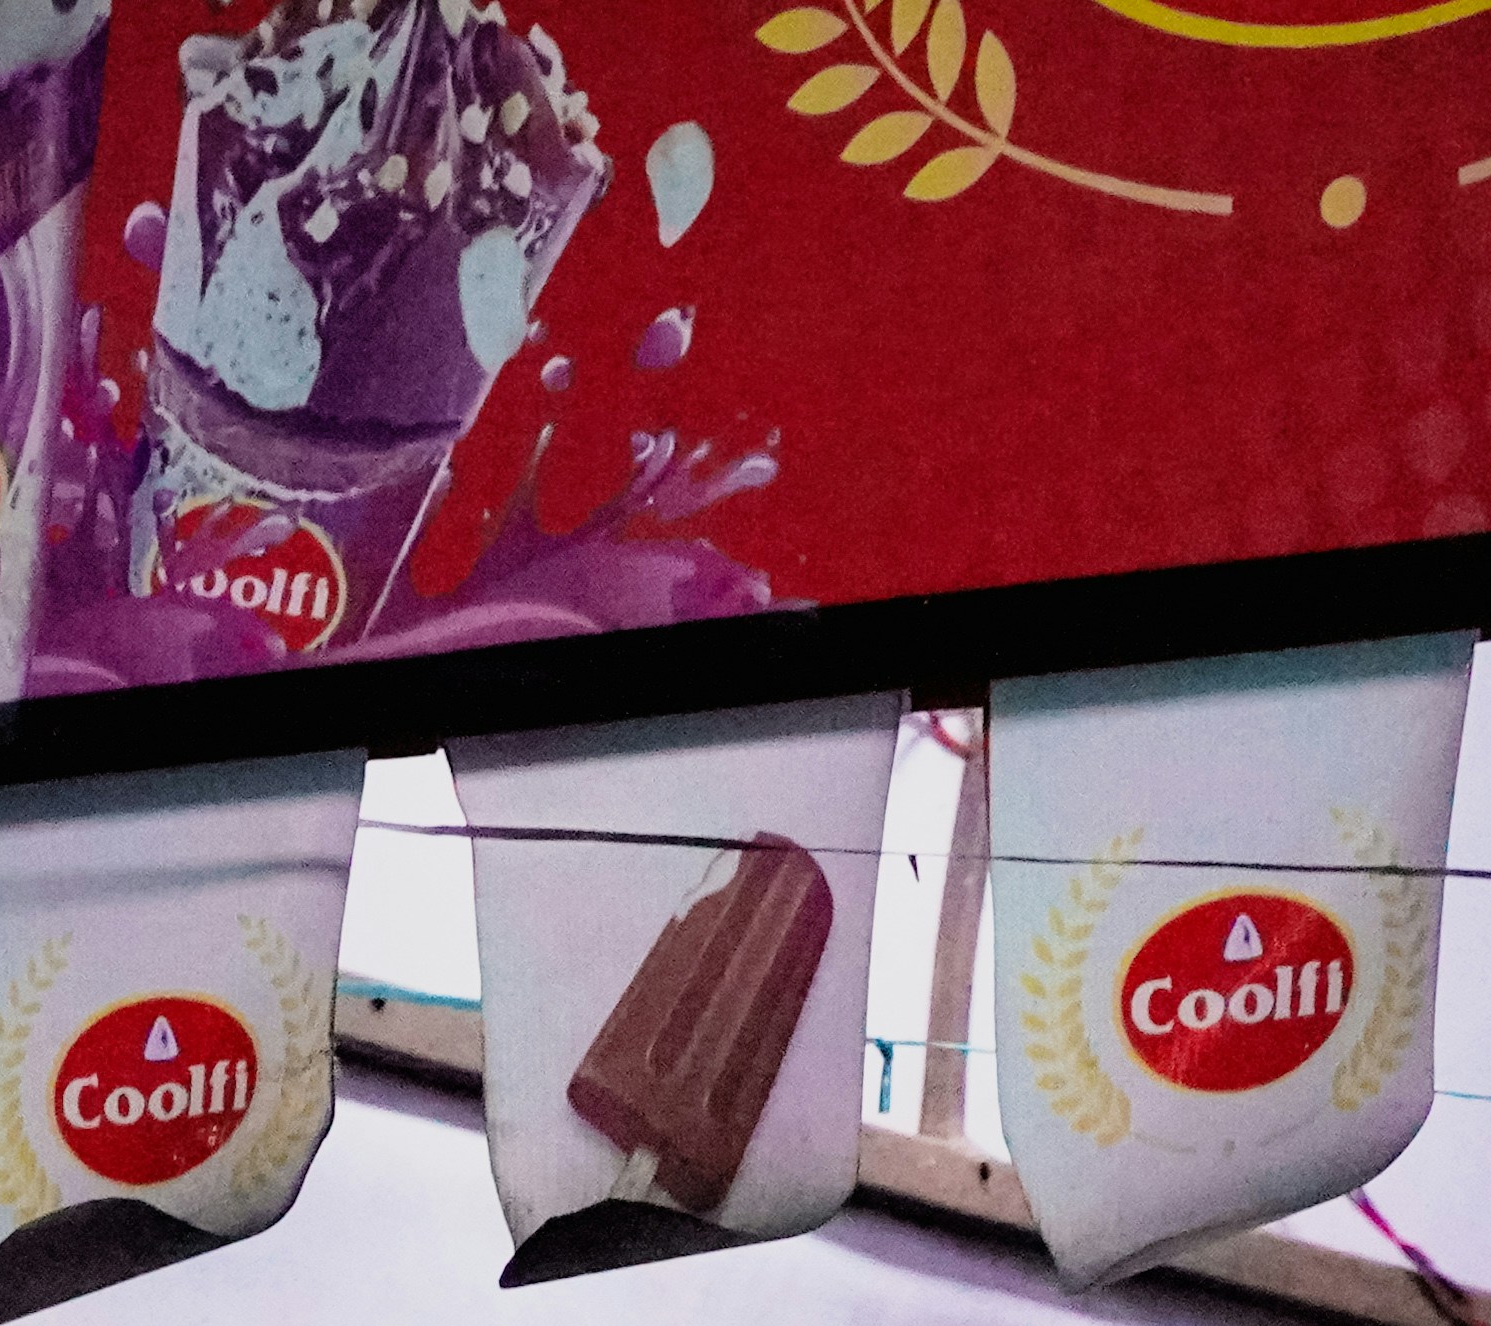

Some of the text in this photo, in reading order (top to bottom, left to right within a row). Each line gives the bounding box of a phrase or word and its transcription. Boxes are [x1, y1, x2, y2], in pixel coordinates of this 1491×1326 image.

[158, 567, 328, 620] oolfi
[1130, 957, 1356, 1036] Coolfi
[62, 1060, 250, 1132] Coolfi
